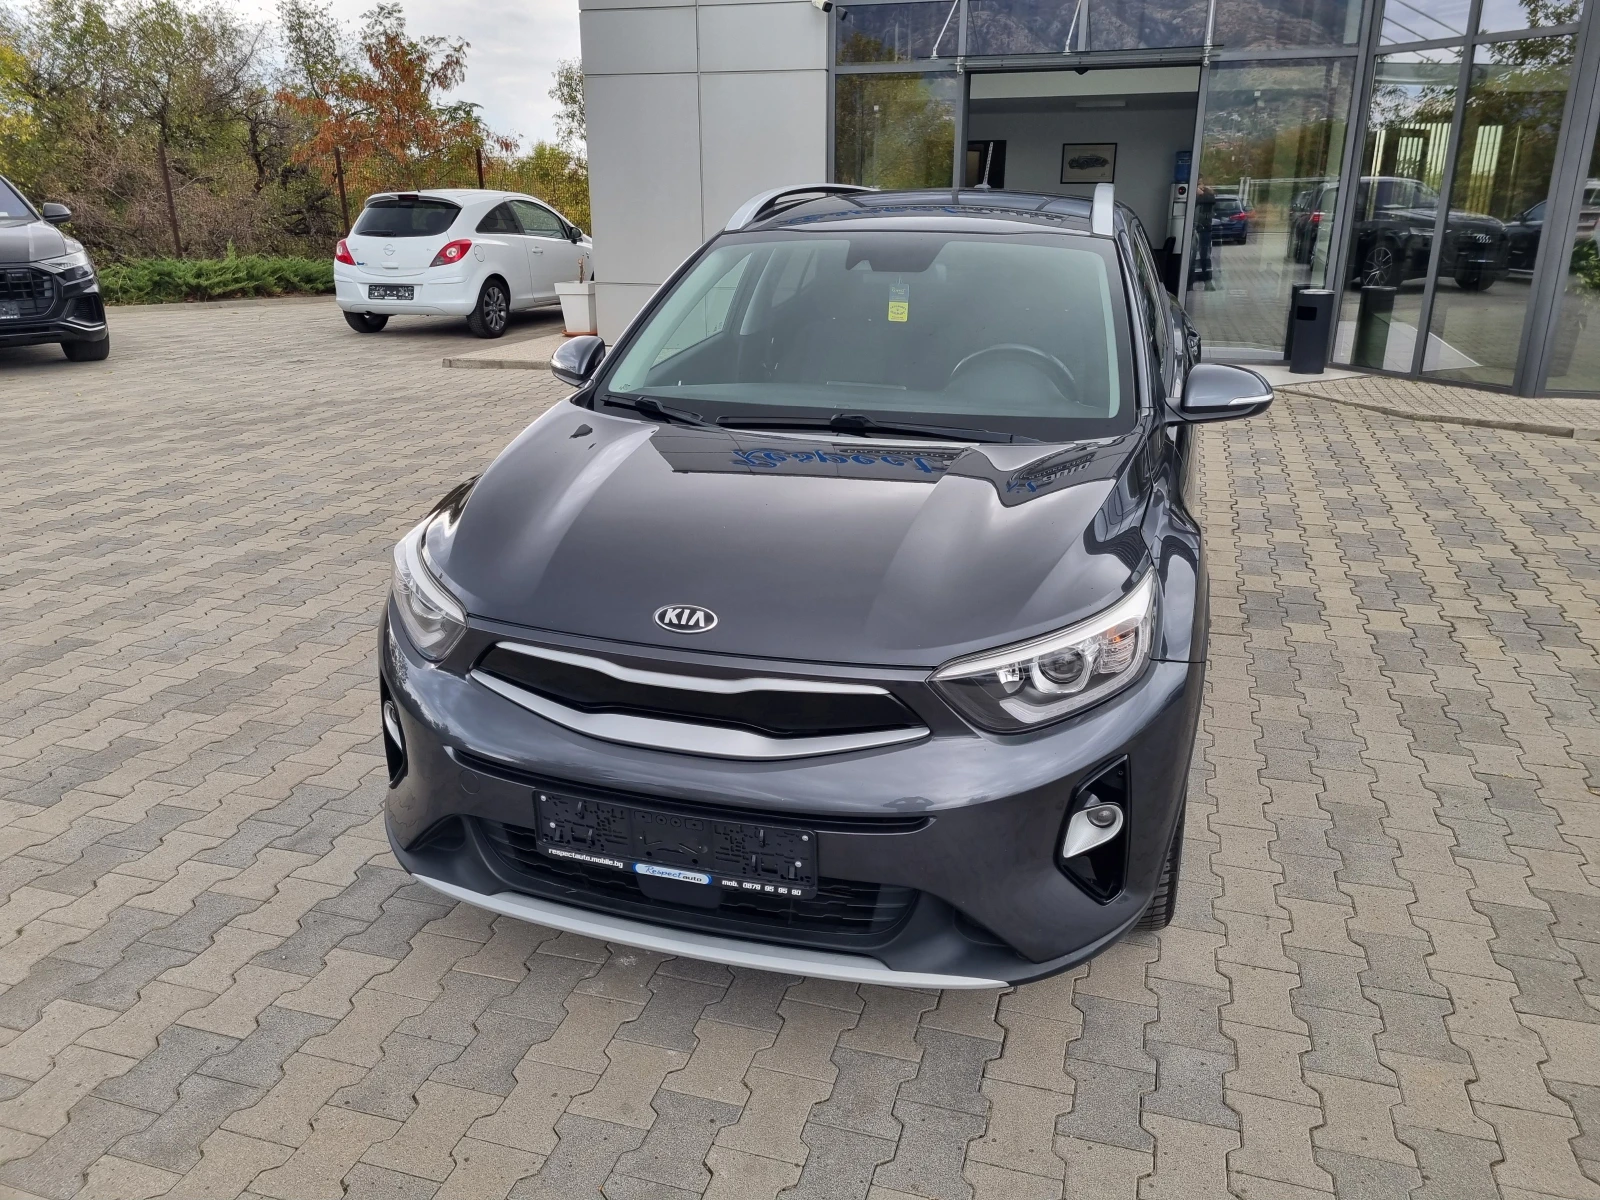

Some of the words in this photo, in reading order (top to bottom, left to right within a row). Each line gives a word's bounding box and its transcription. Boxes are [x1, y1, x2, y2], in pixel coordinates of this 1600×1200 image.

[663, 608, 705, 627] KIA
[548, 848, 624, 868] respectauto.mobile.bg
[645, 865, 684, 879] Respect
[682, 874, 703, 883] auto
[722, 879, 739, 888] mob.
